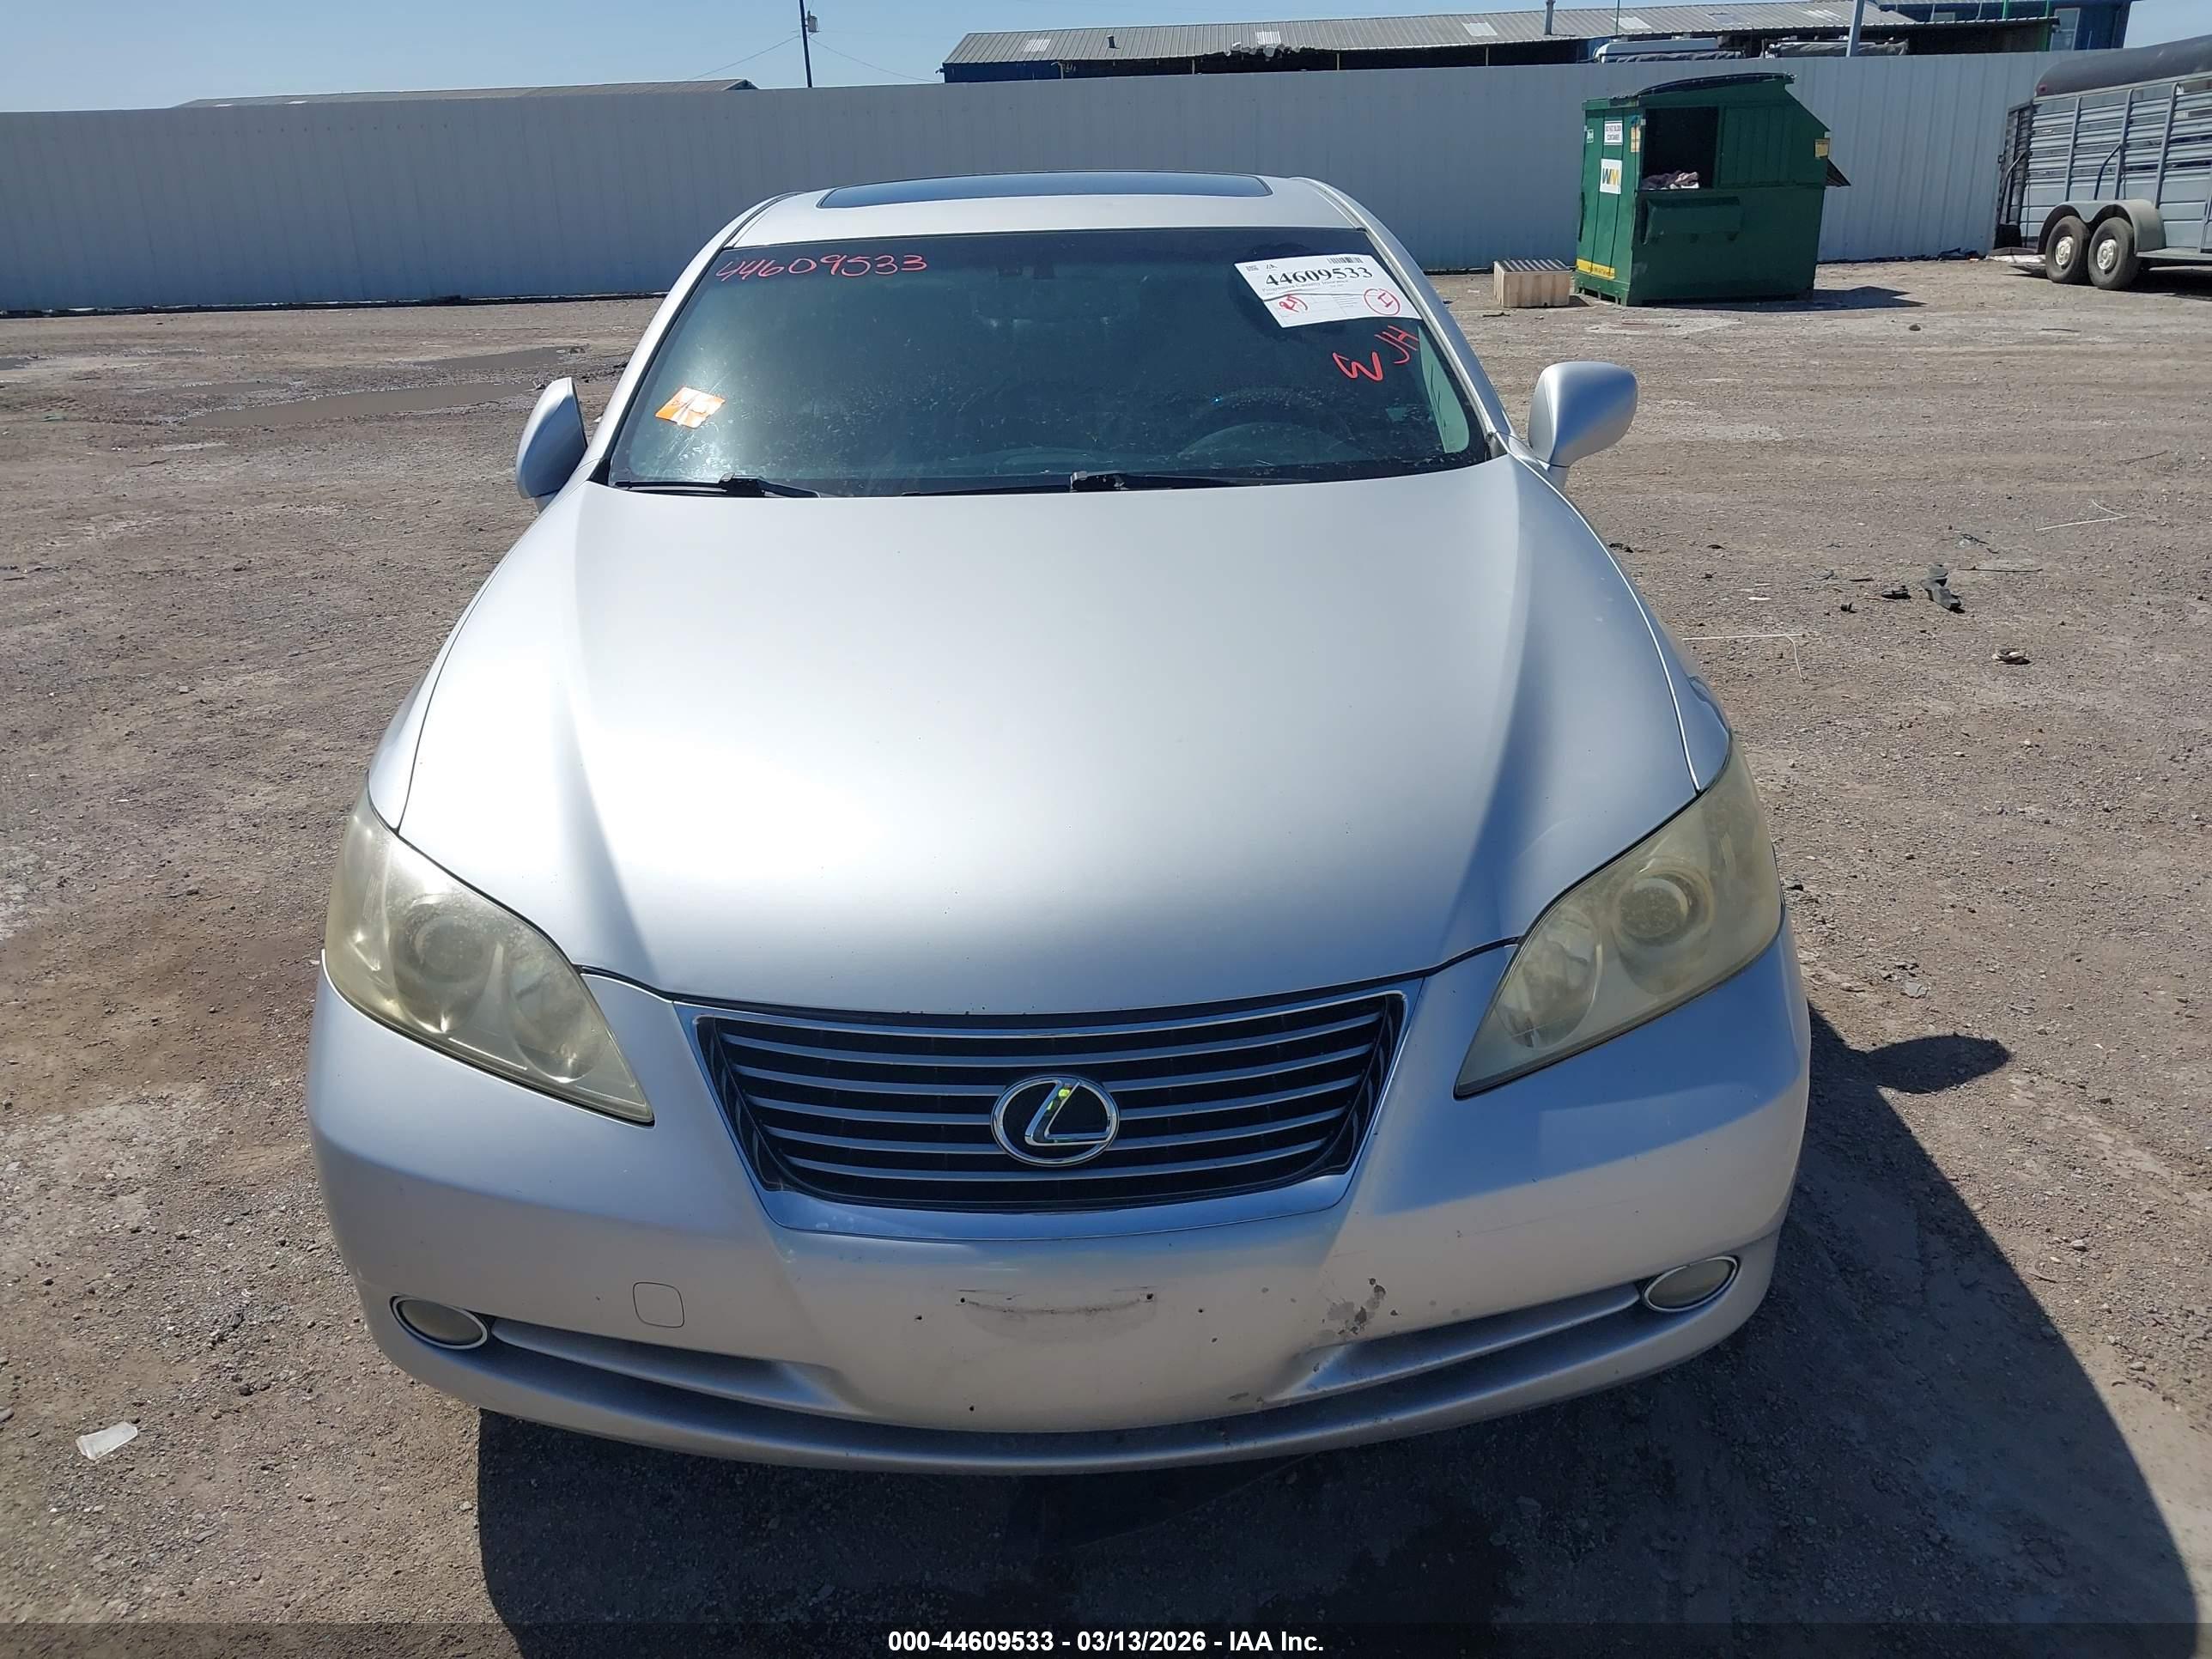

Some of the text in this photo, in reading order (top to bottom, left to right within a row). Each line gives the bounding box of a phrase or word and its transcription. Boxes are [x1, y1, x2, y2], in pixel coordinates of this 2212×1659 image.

[1602, 167, 1620, 185] WM
[715, 254, 927, 282] 44609533
[1266, 267, 1373, 286] 44609533
